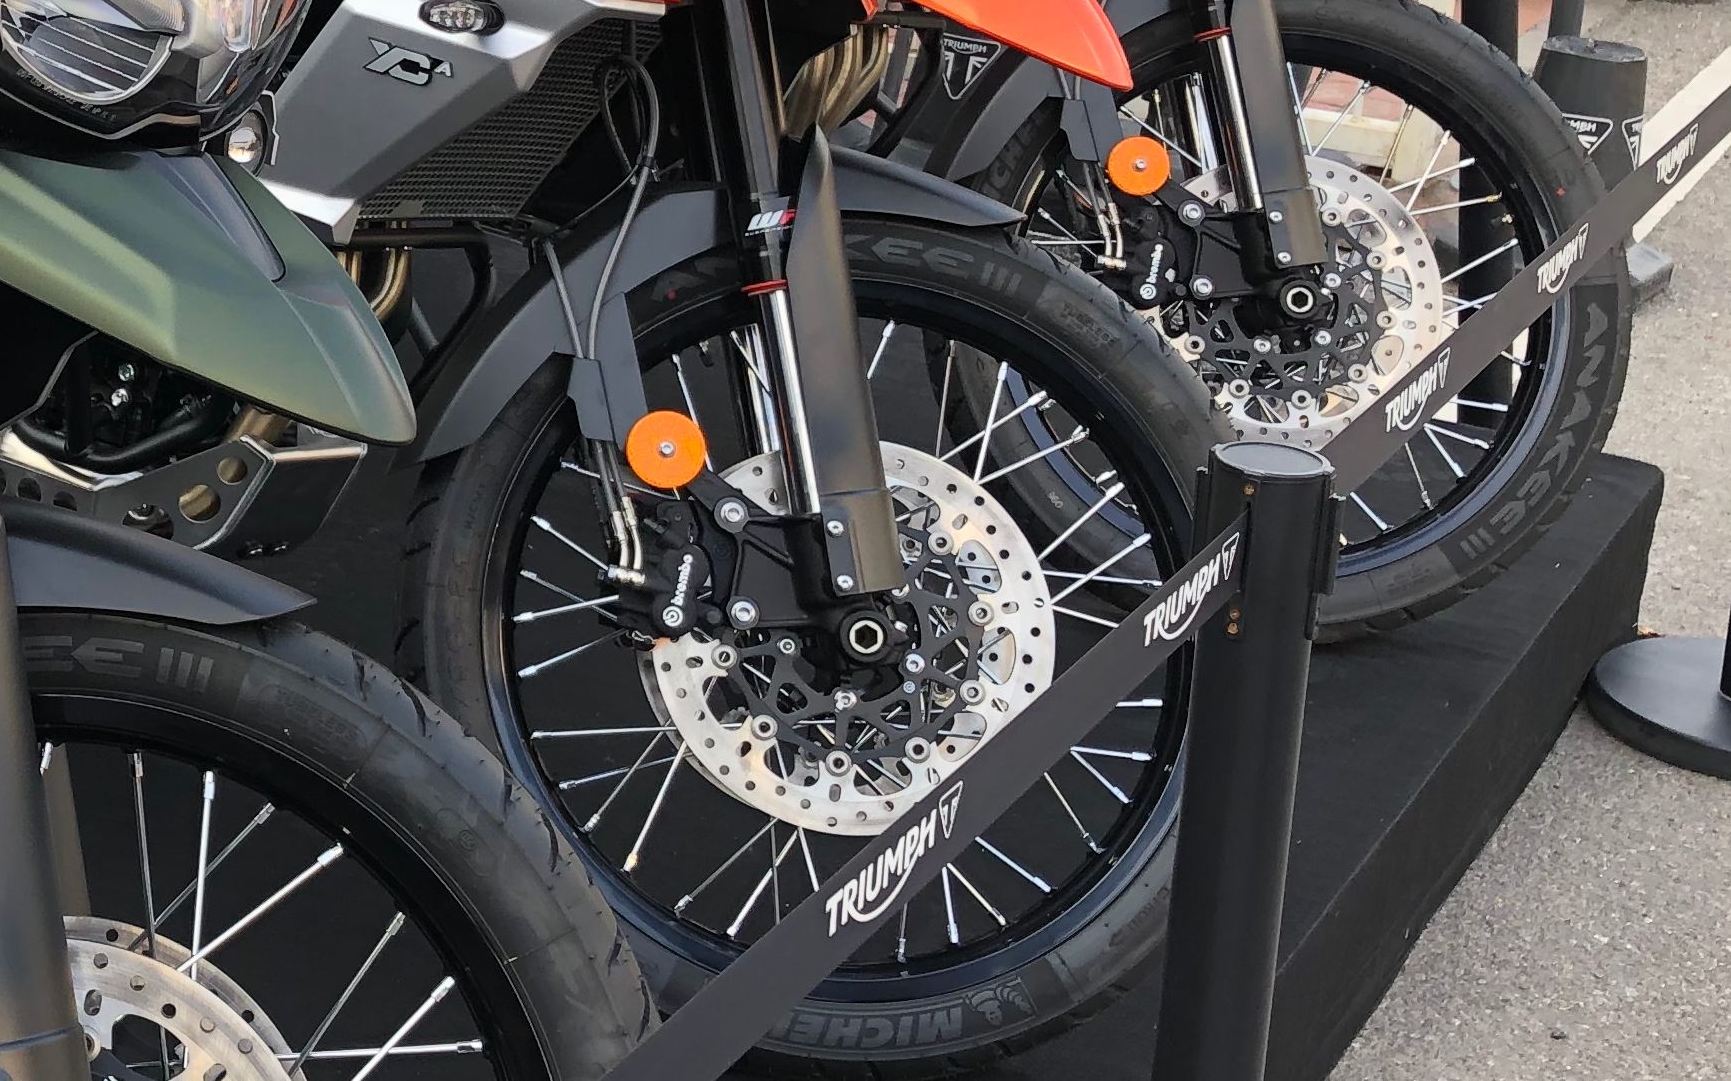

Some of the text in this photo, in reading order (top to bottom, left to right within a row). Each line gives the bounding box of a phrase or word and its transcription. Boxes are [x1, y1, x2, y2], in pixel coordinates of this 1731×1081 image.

[944, 38, 987, 54] TRIUMPH
[1656, 134, 1692, 185] TRIUMPH
[1537, 233, 1580, 294] TRIUMPH
[1386, 362, 1438, 432] TRIUMPH
[670, 554, 693, 606] brembo
[1143, 551, 1221, 646] TRIUMPH
[826, 808, 937, 938] TRIUMPH
